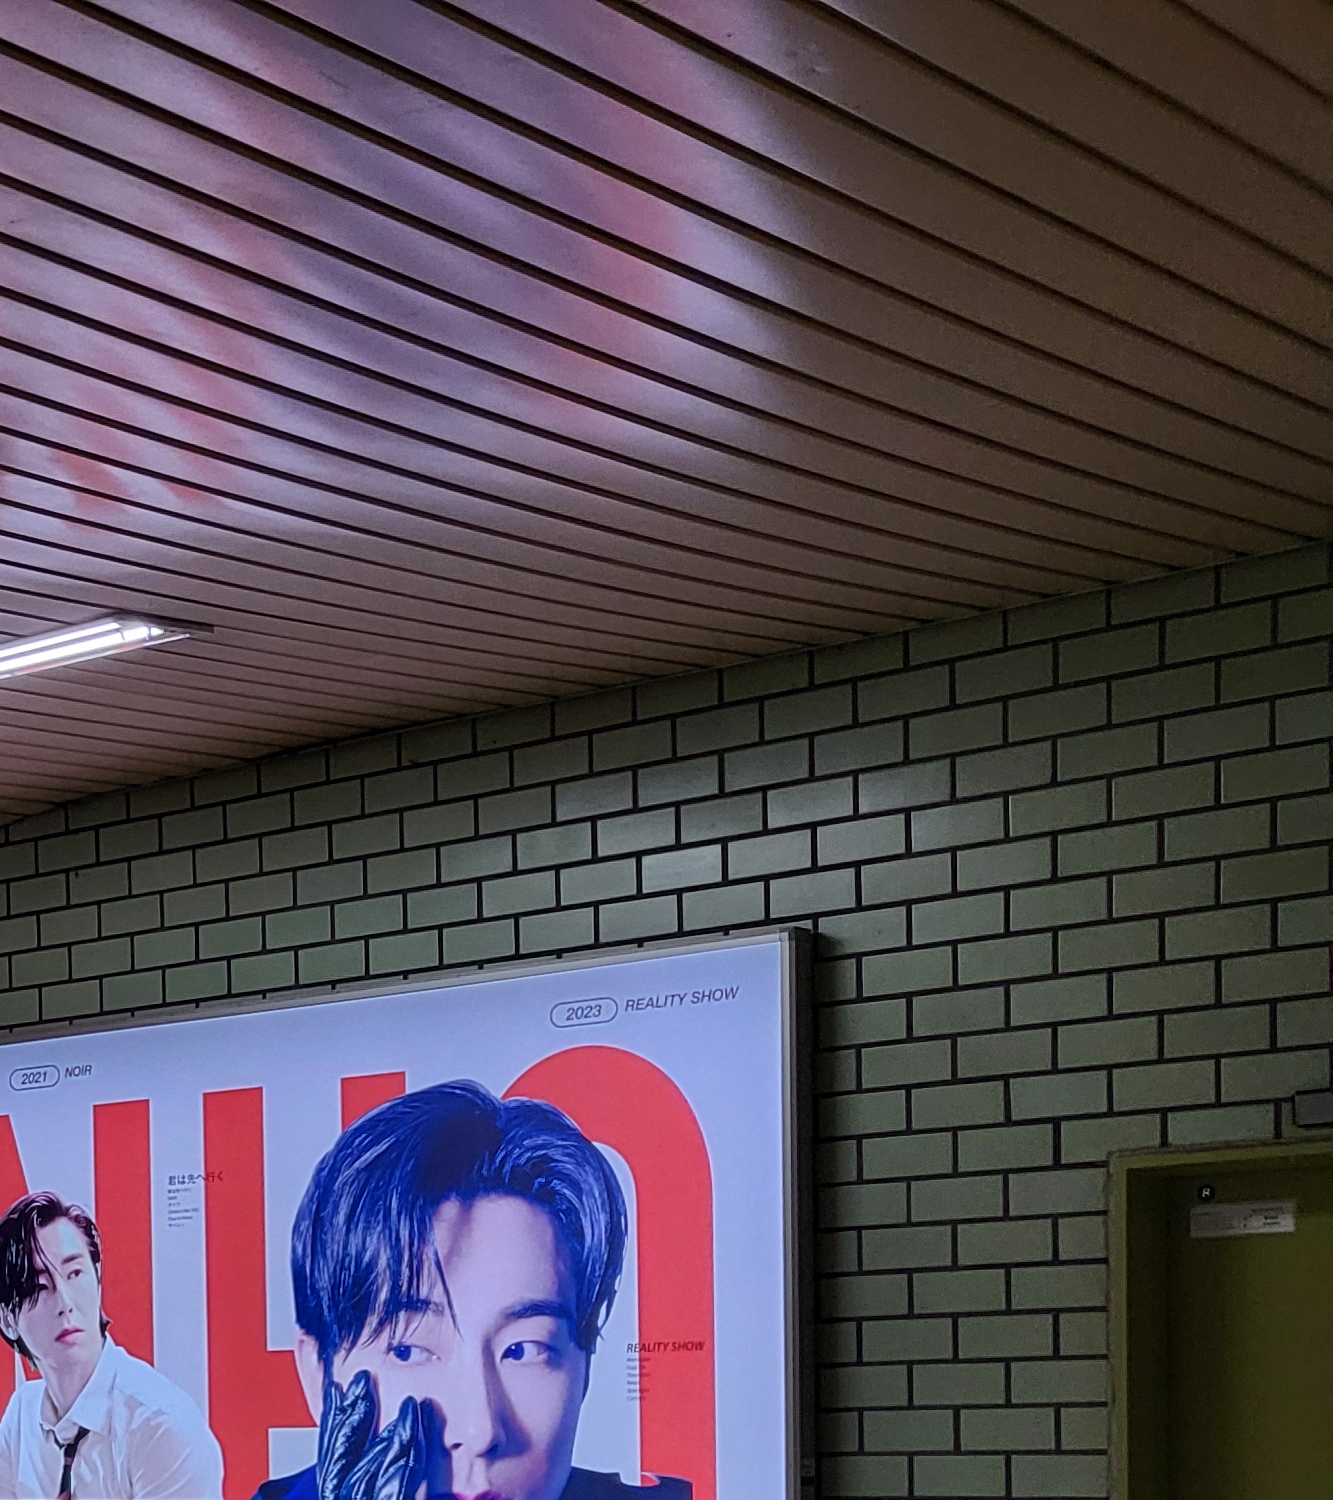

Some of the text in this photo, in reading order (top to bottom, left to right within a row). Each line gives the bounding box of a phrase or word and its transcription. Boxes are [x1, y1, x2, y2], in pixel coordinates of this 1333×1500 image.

[565, 986, 739, 1021] 2023 REALITY SHOW
[21, 1065, 92, 1085] 2021 NOIR
[627, 1340, 706, 1353] REALITY SHOW
